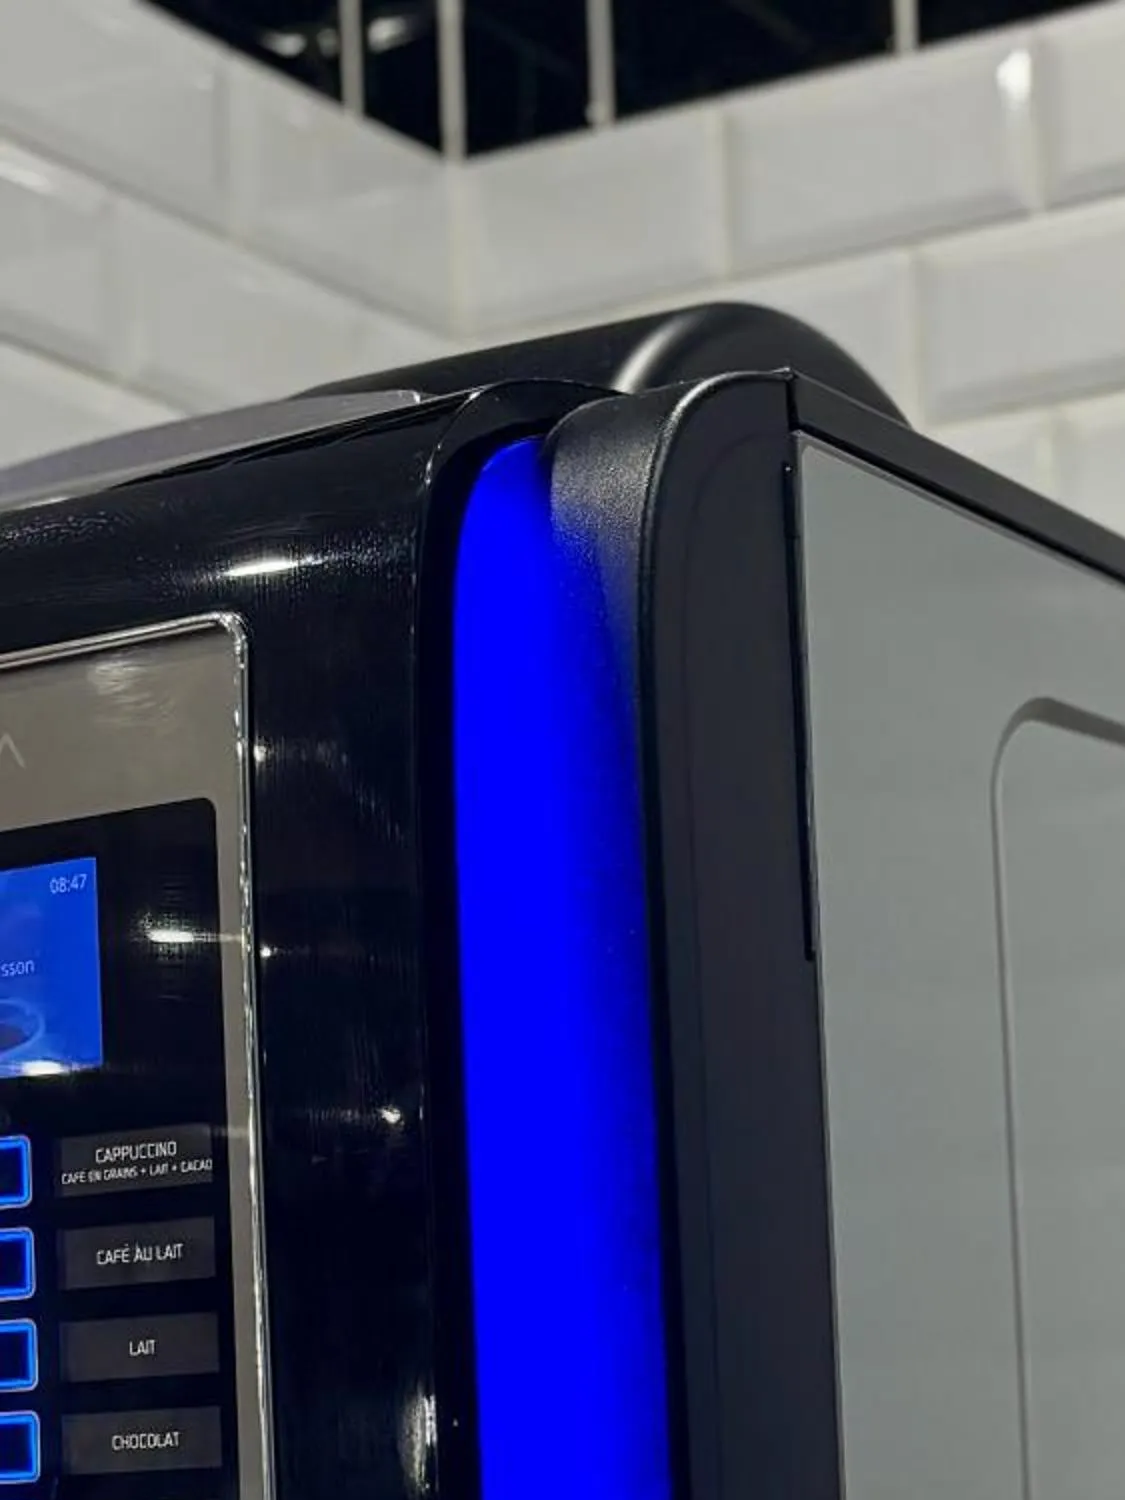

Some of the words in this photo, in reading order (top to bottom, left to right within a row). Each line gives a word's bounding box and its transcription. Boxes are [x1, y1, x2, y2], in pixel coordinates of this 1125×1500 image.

[48, 873, 88, 895] 08:47
[95, 1140, 177, 1164] CAPPUCCINO
[149, 1163, 169, 1177] LAIT
[180, 1158, 213, 1173] CACAO
[155, 1243, 184, 1261] LAIT
[128, 1339, 156, 1356] LAIT
[111, 1431, 181, 1451] CHOCOLAT
